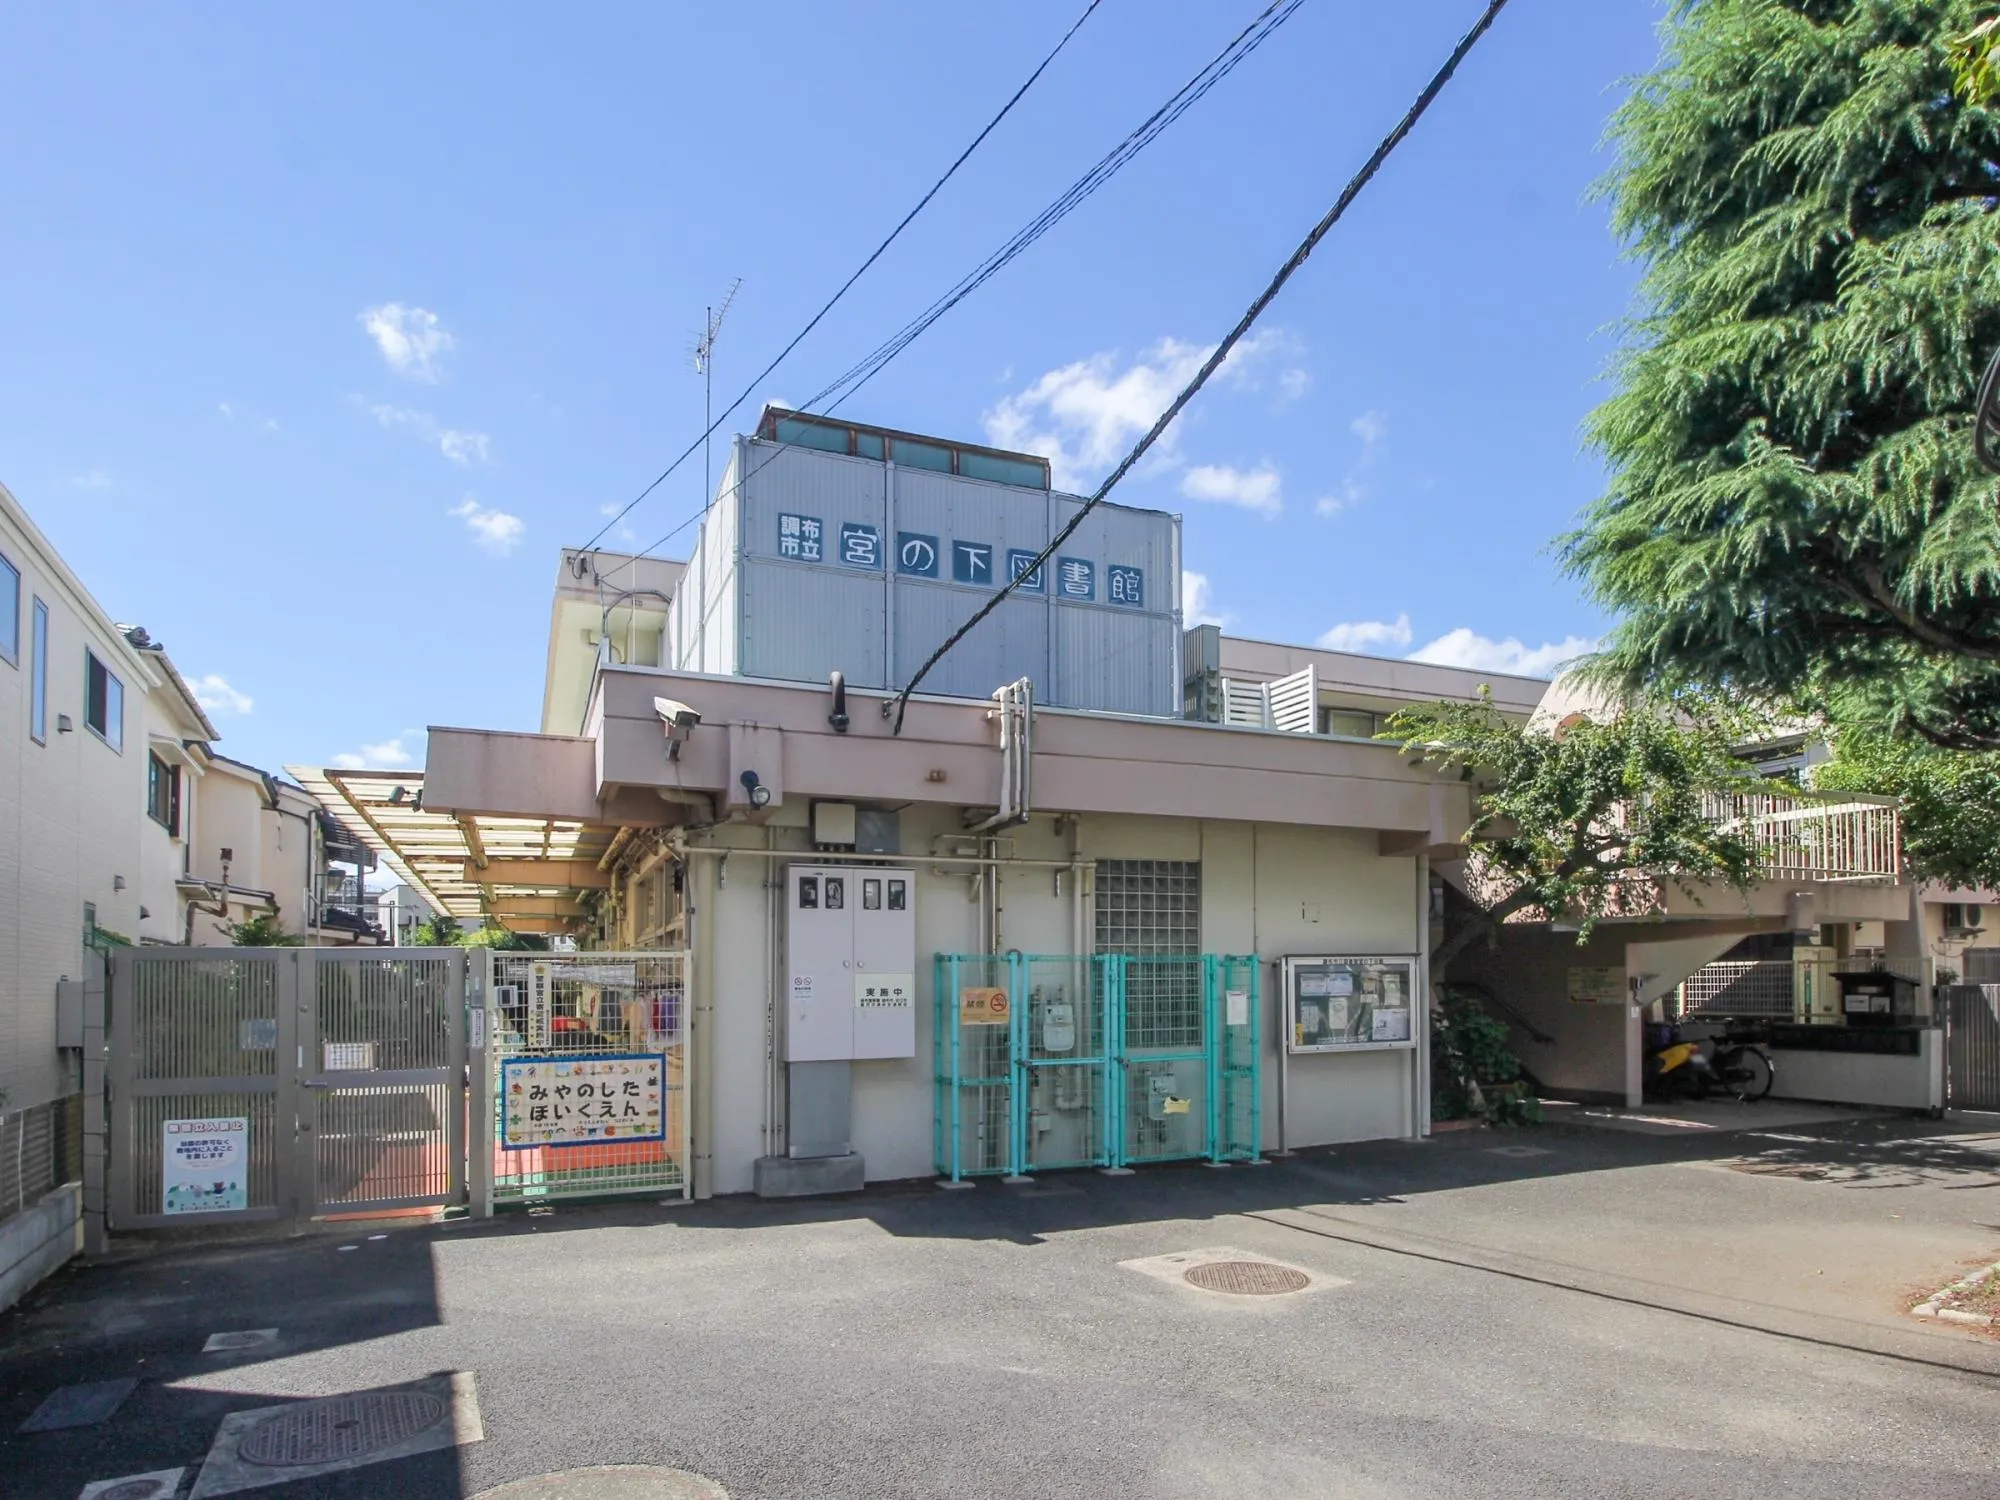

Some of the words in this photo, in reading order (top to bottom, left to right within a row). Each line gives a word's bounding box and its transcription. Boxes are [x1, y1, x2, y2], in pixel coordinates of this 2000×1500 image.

[781, 514, 820, 539] 調布
[781, 536, 820, 560] 市立
[843, 528, 1140, 603] 宮の下図書館
[865, 987, 902, 997] 実施中
[529, 1080, 640, 1100] みやのした
[529, 1100, 640, 1121] ほいくえん
